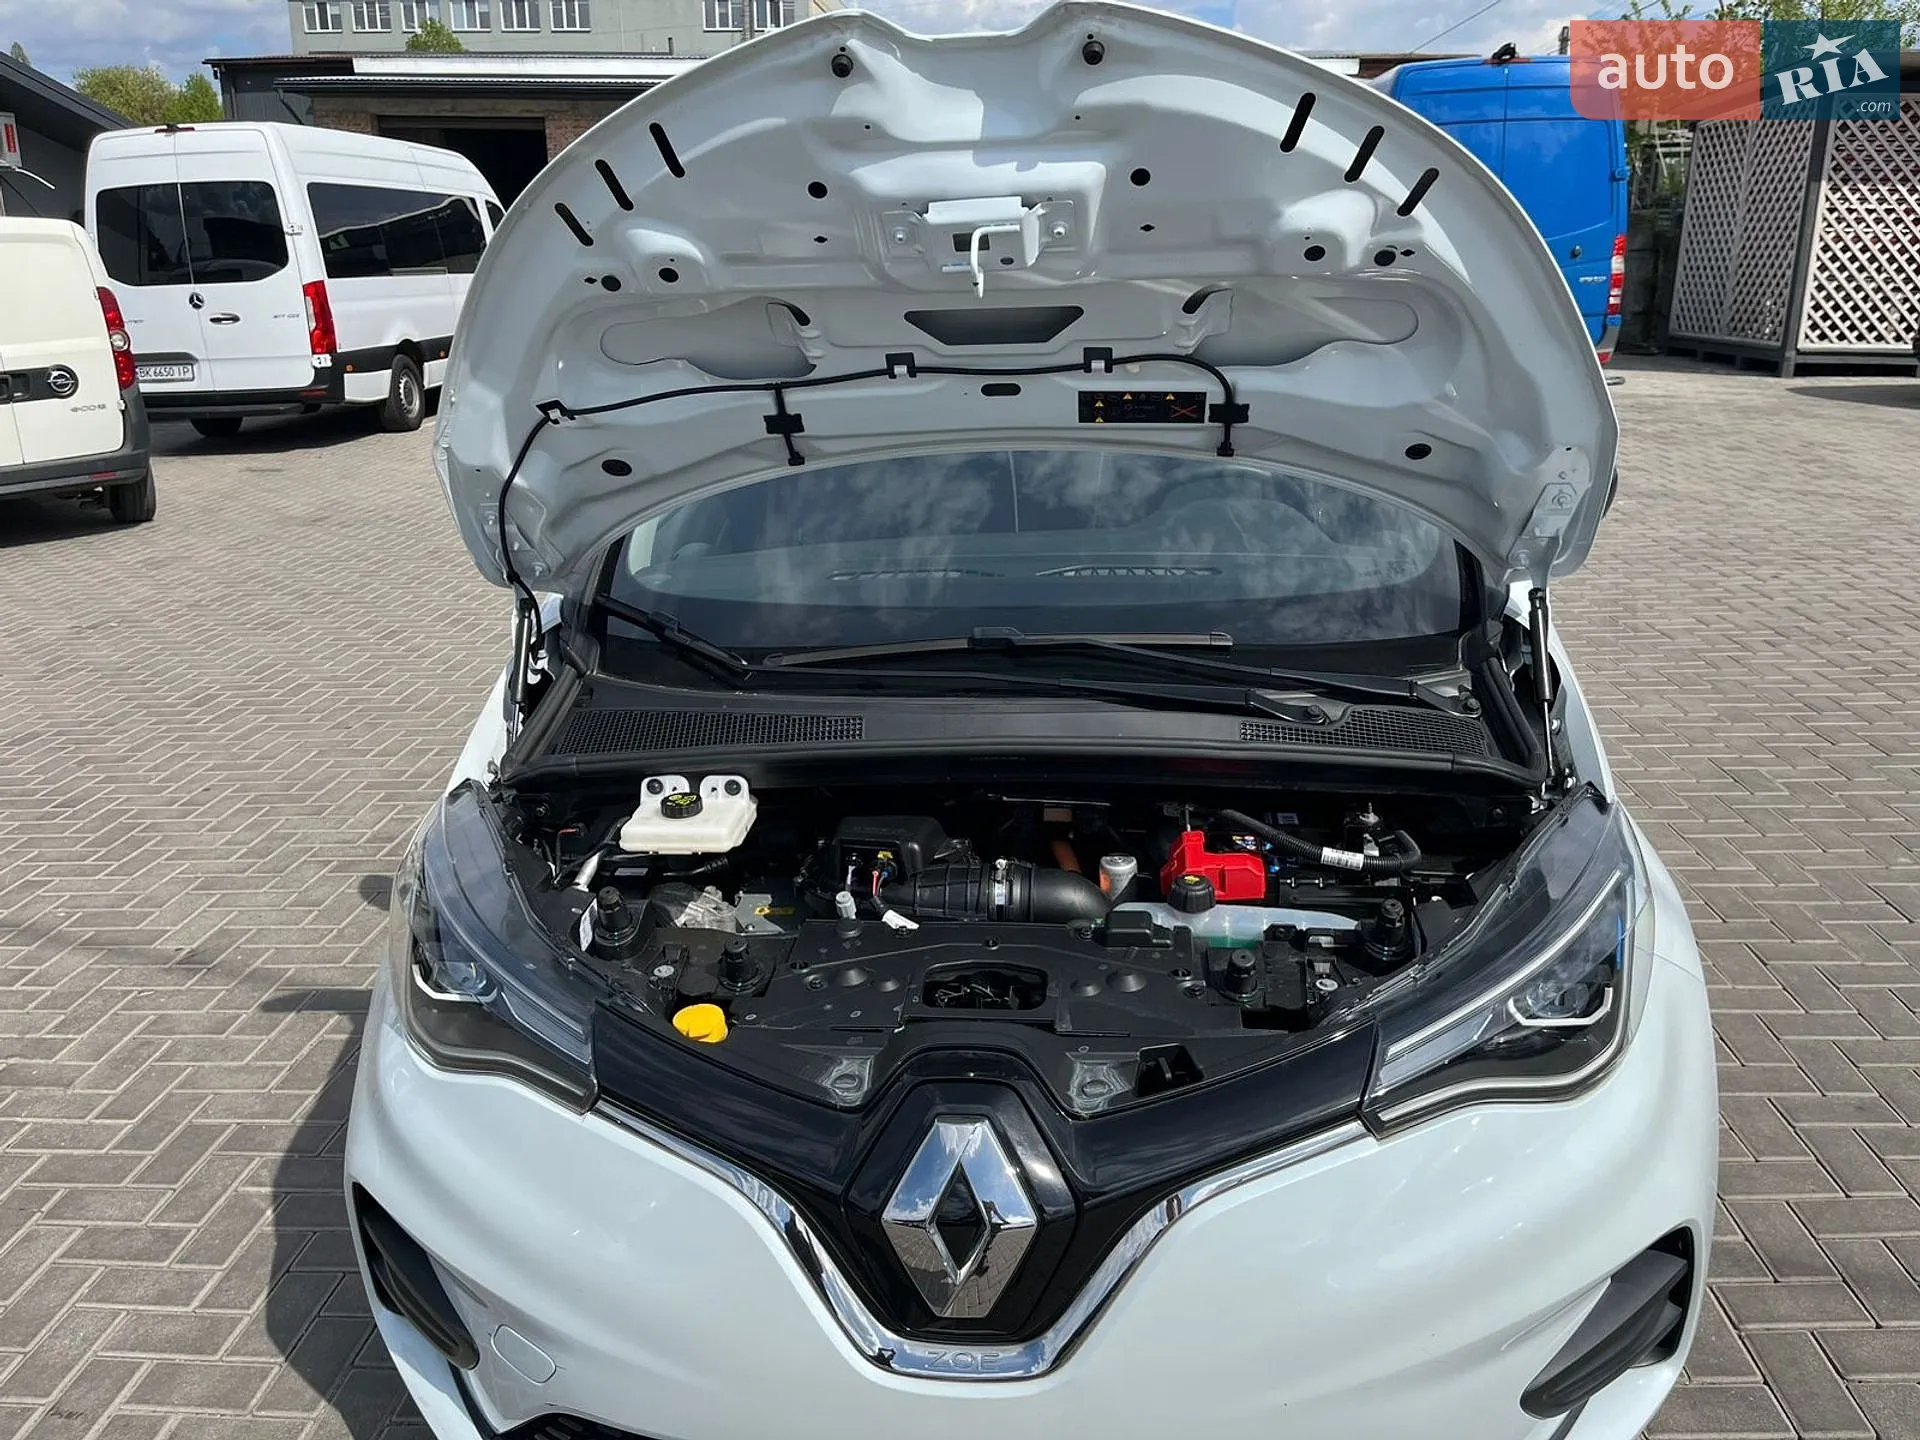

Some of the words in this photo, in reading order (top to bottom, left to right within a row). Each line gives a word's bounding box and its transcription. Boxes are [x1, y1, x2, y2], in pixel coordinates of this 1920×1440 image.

[139, 367, 152, 378] BK
[153, 366, 175, 377] 6650
[925, 1350, 1001, 1374] ZOE
